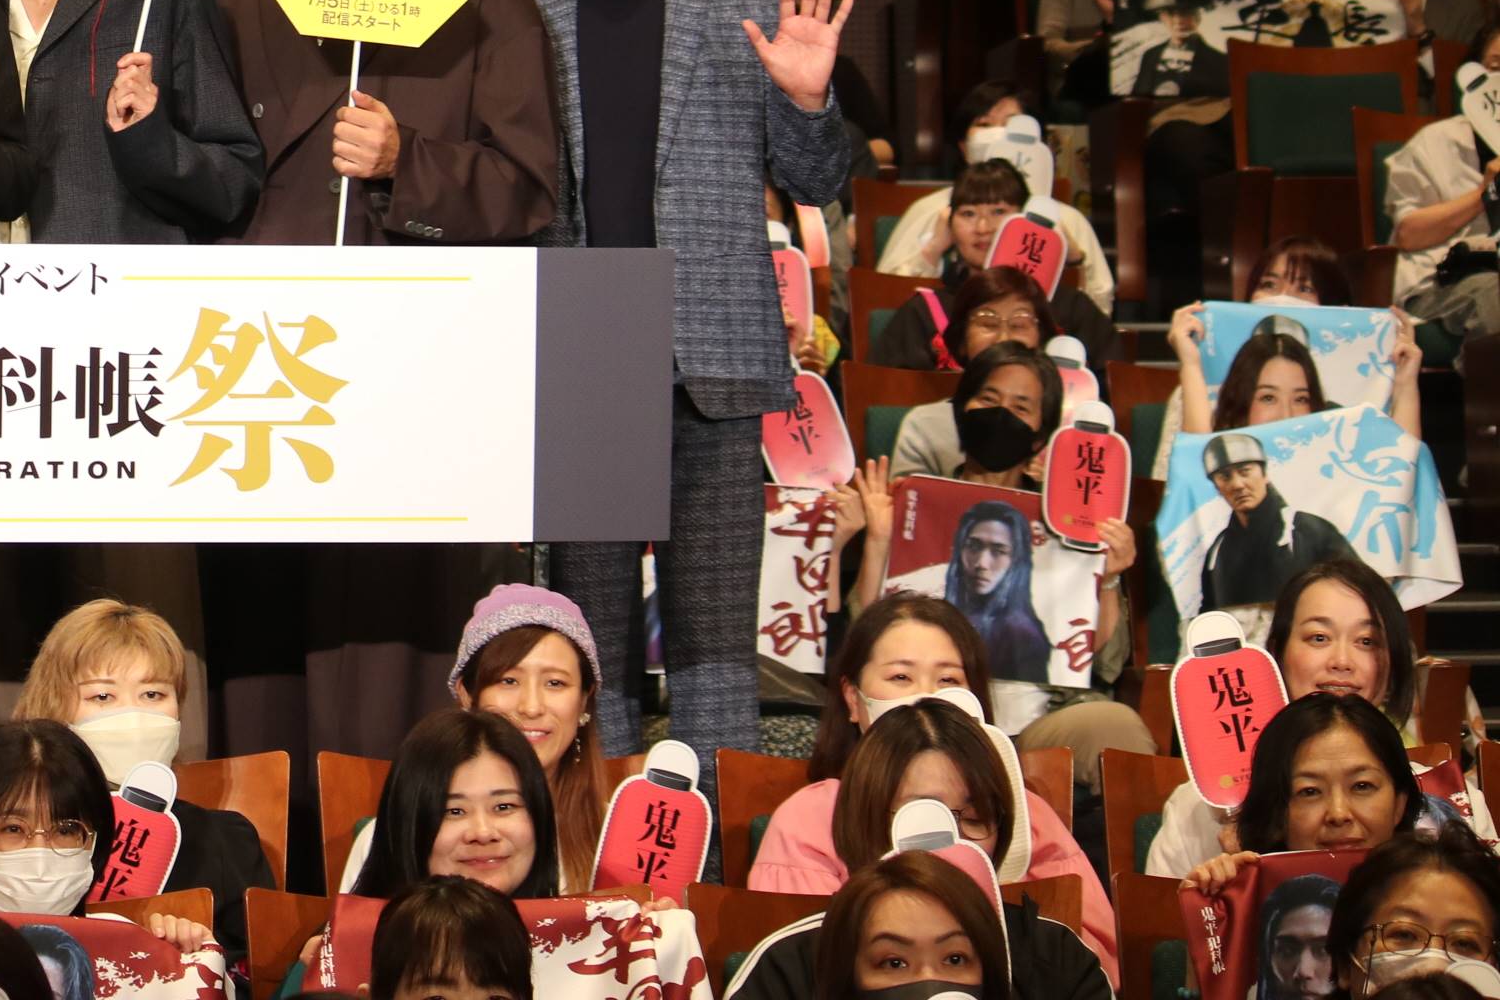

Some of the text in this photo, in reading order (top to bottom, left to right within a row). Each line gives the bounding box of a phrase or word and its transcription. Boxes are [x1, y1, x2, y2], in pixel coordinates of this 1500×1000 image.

[322, 9, 402, 32] 配信スタート
[1075, 442, 1105, 506] 鬼平
[1208, 667, 1261, 753] 鬼平
[635, 800, 681, 885] 鬼平
